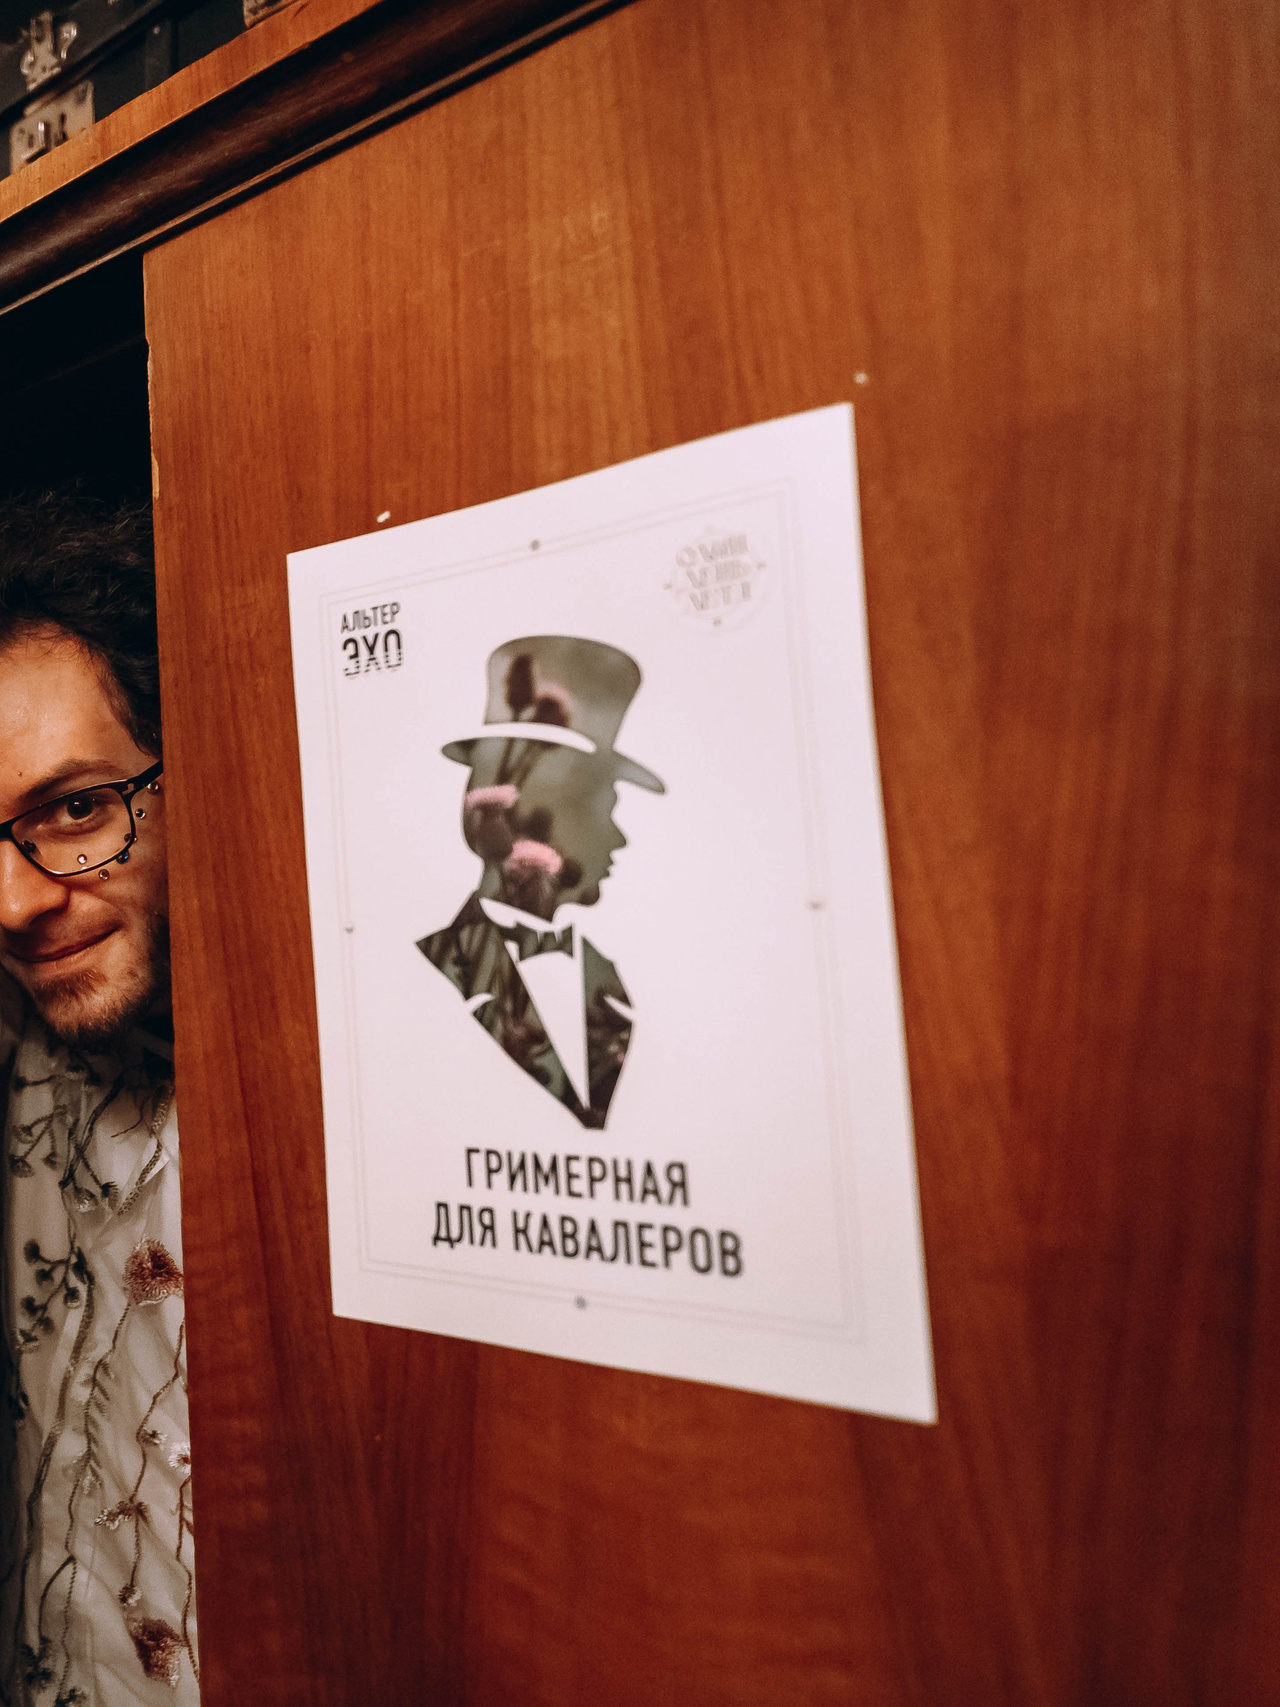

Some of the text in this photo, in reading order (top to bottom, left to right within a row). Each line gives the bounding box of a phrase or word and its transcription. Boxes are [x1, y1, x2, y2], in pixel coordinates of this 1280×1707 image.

[341, 602, 401, 633] АЛЬТЕР
[342, 629, 402, 677] ЭХО
[465, 1147, 690, 1207] ГРИМЕРНАЯ
[432, 1202, 743, 1278] ДЛЯ КАВАЛЕРОВ
